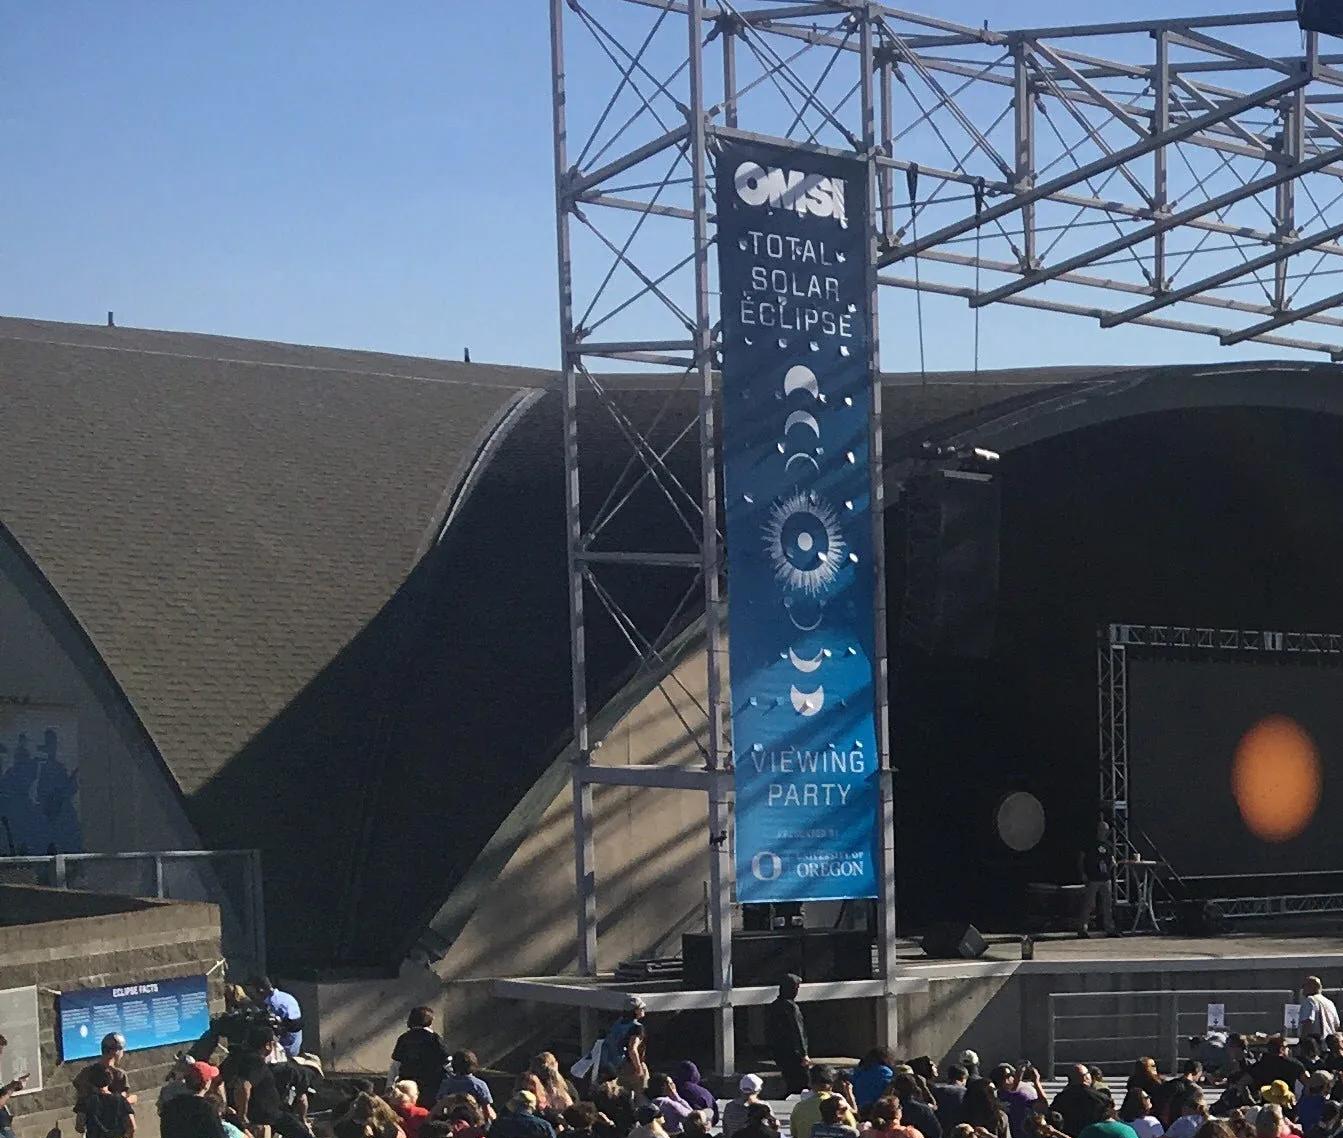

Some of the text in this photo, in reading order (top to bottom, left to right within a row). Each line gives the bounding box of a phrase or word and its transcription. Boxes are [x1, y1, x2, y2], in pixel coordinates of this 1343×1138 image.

[734, 161, 848, 219] OMSI
[748, 230, 833, 266] TOTAL
[751, 266, 840, 302] SOLAR
[740, 299, 853, 338] ECLIPSE
[751, 750, 865, 773] VIEWING
[768, 783, 851, 806] PARTY
[796, 860, 864, 878] OREGON
[112, 983, 159, 998] ECLIPSE FACTS
